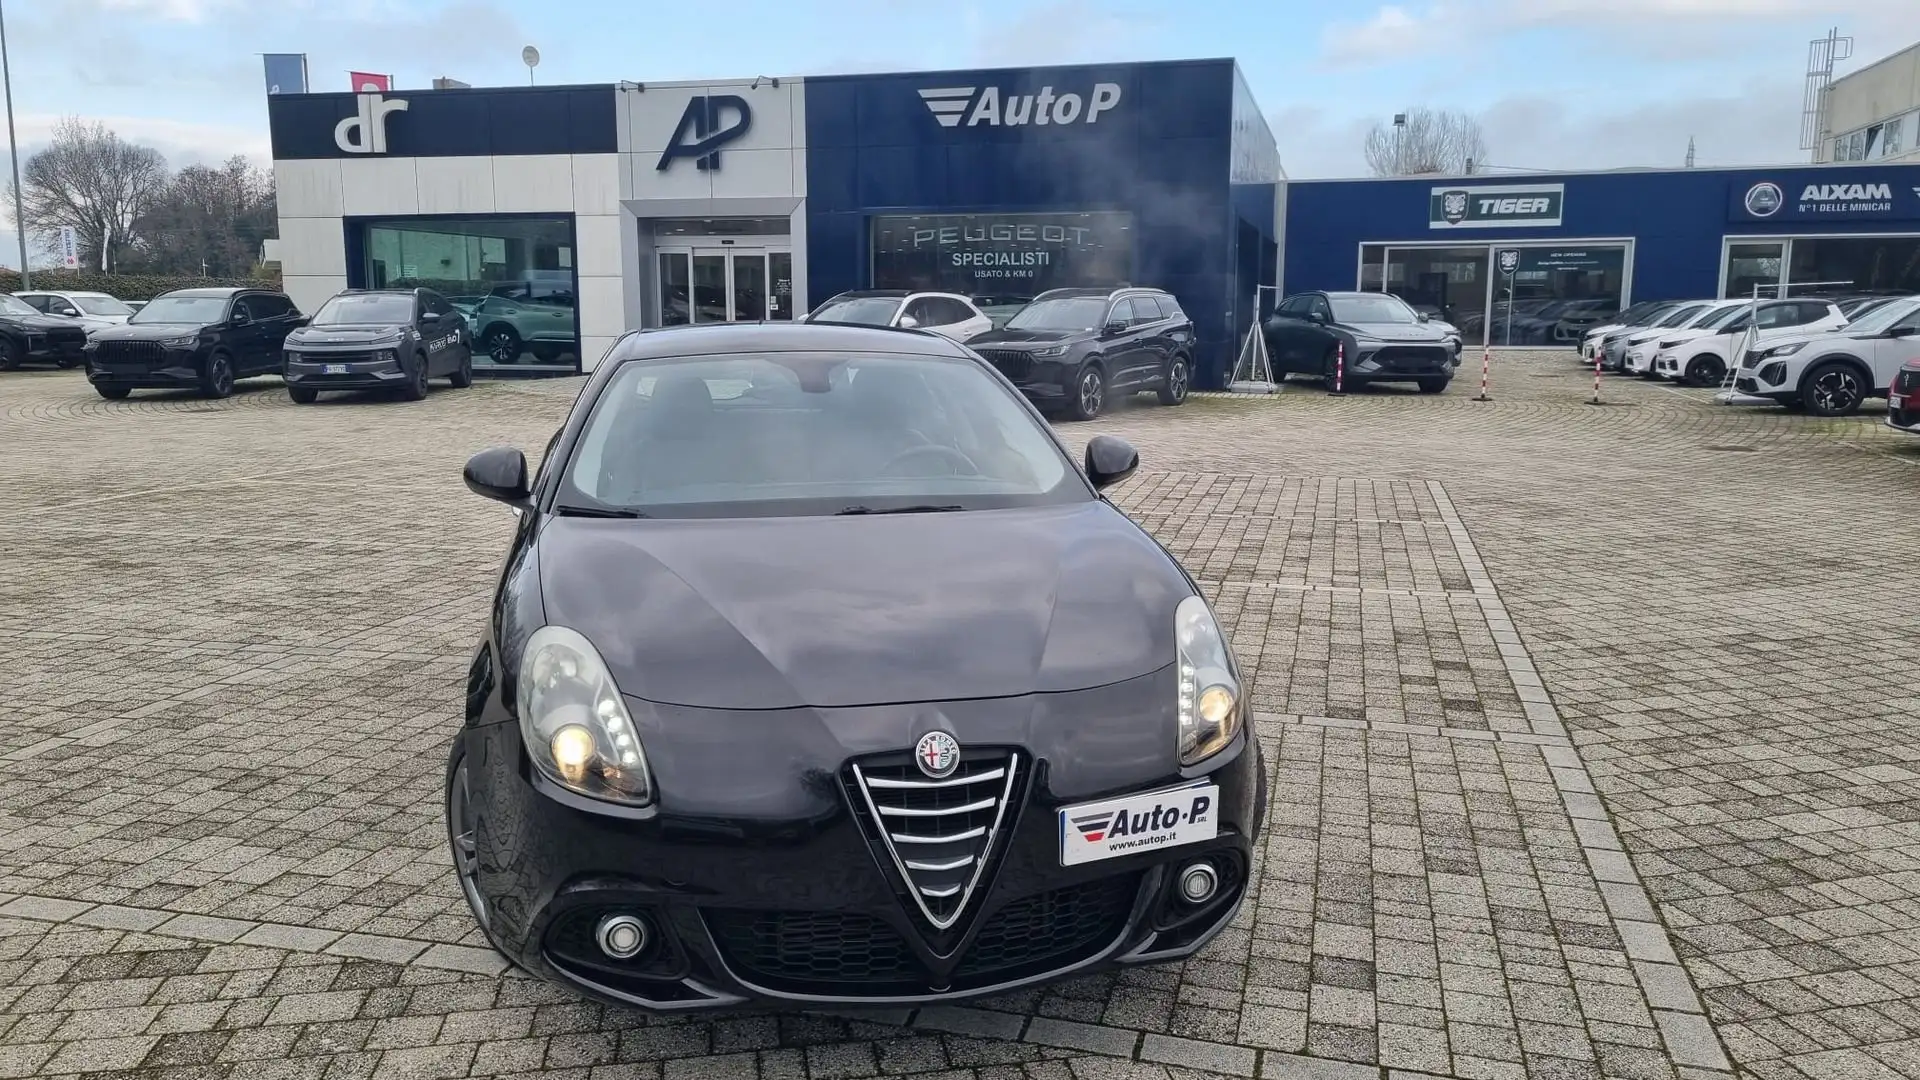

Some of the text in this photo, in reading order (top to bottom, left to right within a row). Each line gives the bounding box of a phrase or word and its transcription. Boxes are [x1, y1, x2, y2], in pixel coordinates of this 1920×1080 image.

[967, 83, 1122, 127] Auto P
[335, 94, 408, 153] dr
[1800, 184, 1892, 201] AIXAM
[1479, 198, 1550, 215] TIGER
[1819, 203, 1848, 212] DELLE
[1850, 202, 1891, 212] MINICAR
[913, 224, 1090, 247] PEUGEOT
[952, 251, 1049, 266] SPECIALISTI
[975, 268, 1033, 278] USATO & KM 0
[1109, 831, 1177, 852] www.autop.it
